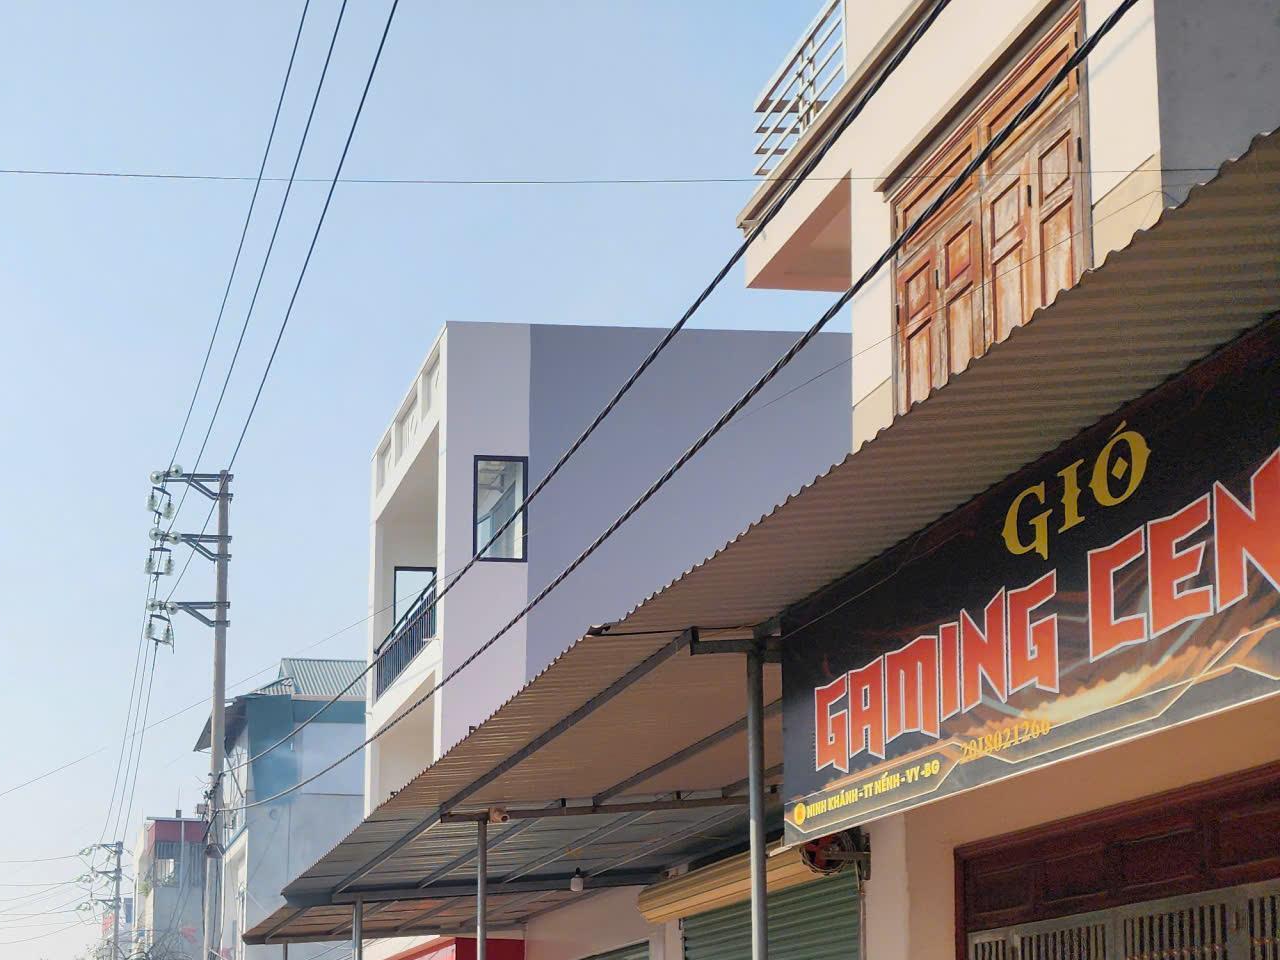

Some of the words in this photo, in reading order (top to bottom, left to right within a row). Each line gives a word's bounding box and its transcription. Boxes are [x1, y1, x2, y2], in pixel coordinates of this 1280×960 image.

[1001, 421, 1152, 561] GIÓ
[814, 569, 1060, 773] GAMING
[1087, 447, 1280, 663] CEN
